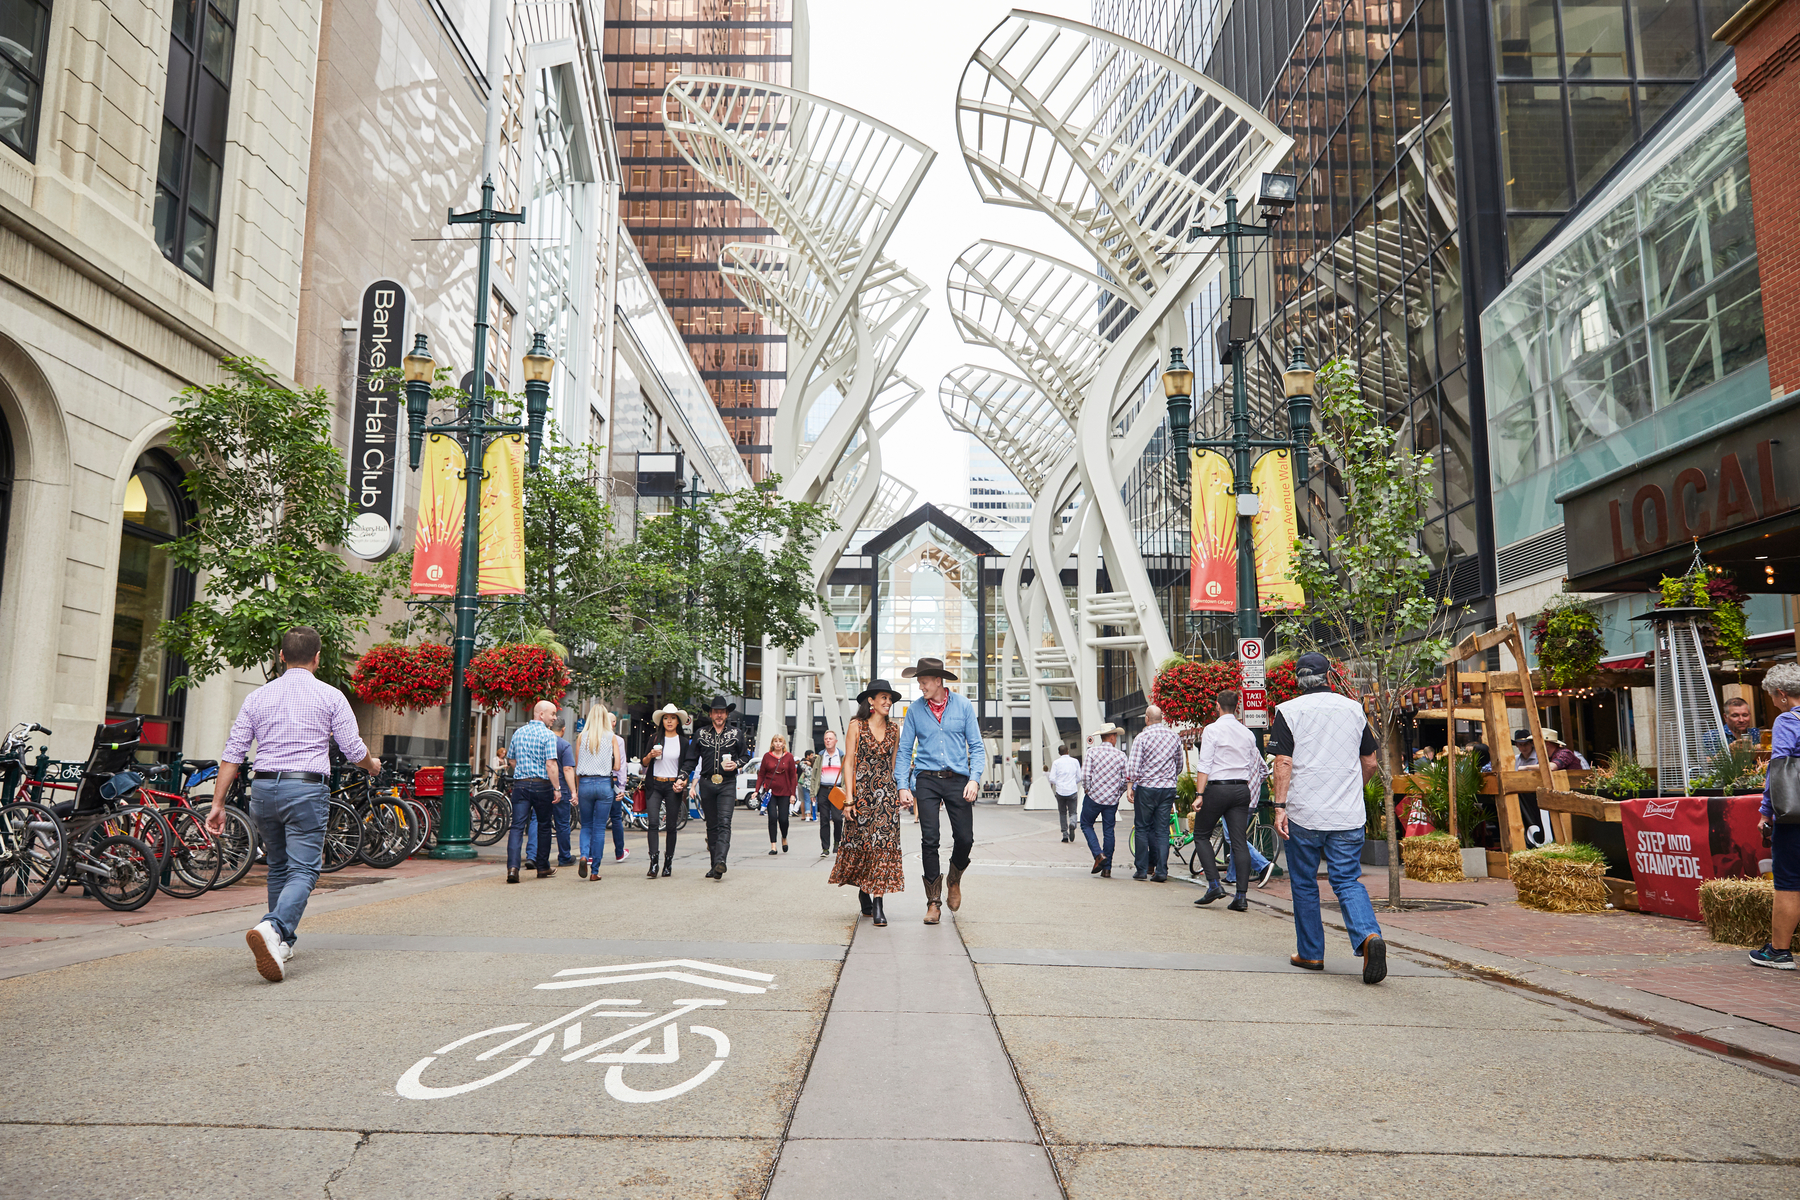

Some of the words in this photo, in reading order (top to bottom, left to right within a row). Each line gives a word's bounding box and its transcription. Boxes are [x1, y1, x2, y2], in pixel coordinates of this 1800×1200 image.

[364, 397, 388, 444] Hall
[360, 448, 385, 508] Club
[510, 467, 521, 510] Avenue
[1282, 483, 1294, 525] Avenue
[1609, 439, 1791, 564] LOCAL
[510, 512, 523, 560] Stephen
[1637, 830, 1666, 853] STEP
[1667, 834, 1692, 852] INTO
[1635, 851, 1703, 880] STAMPEDE
